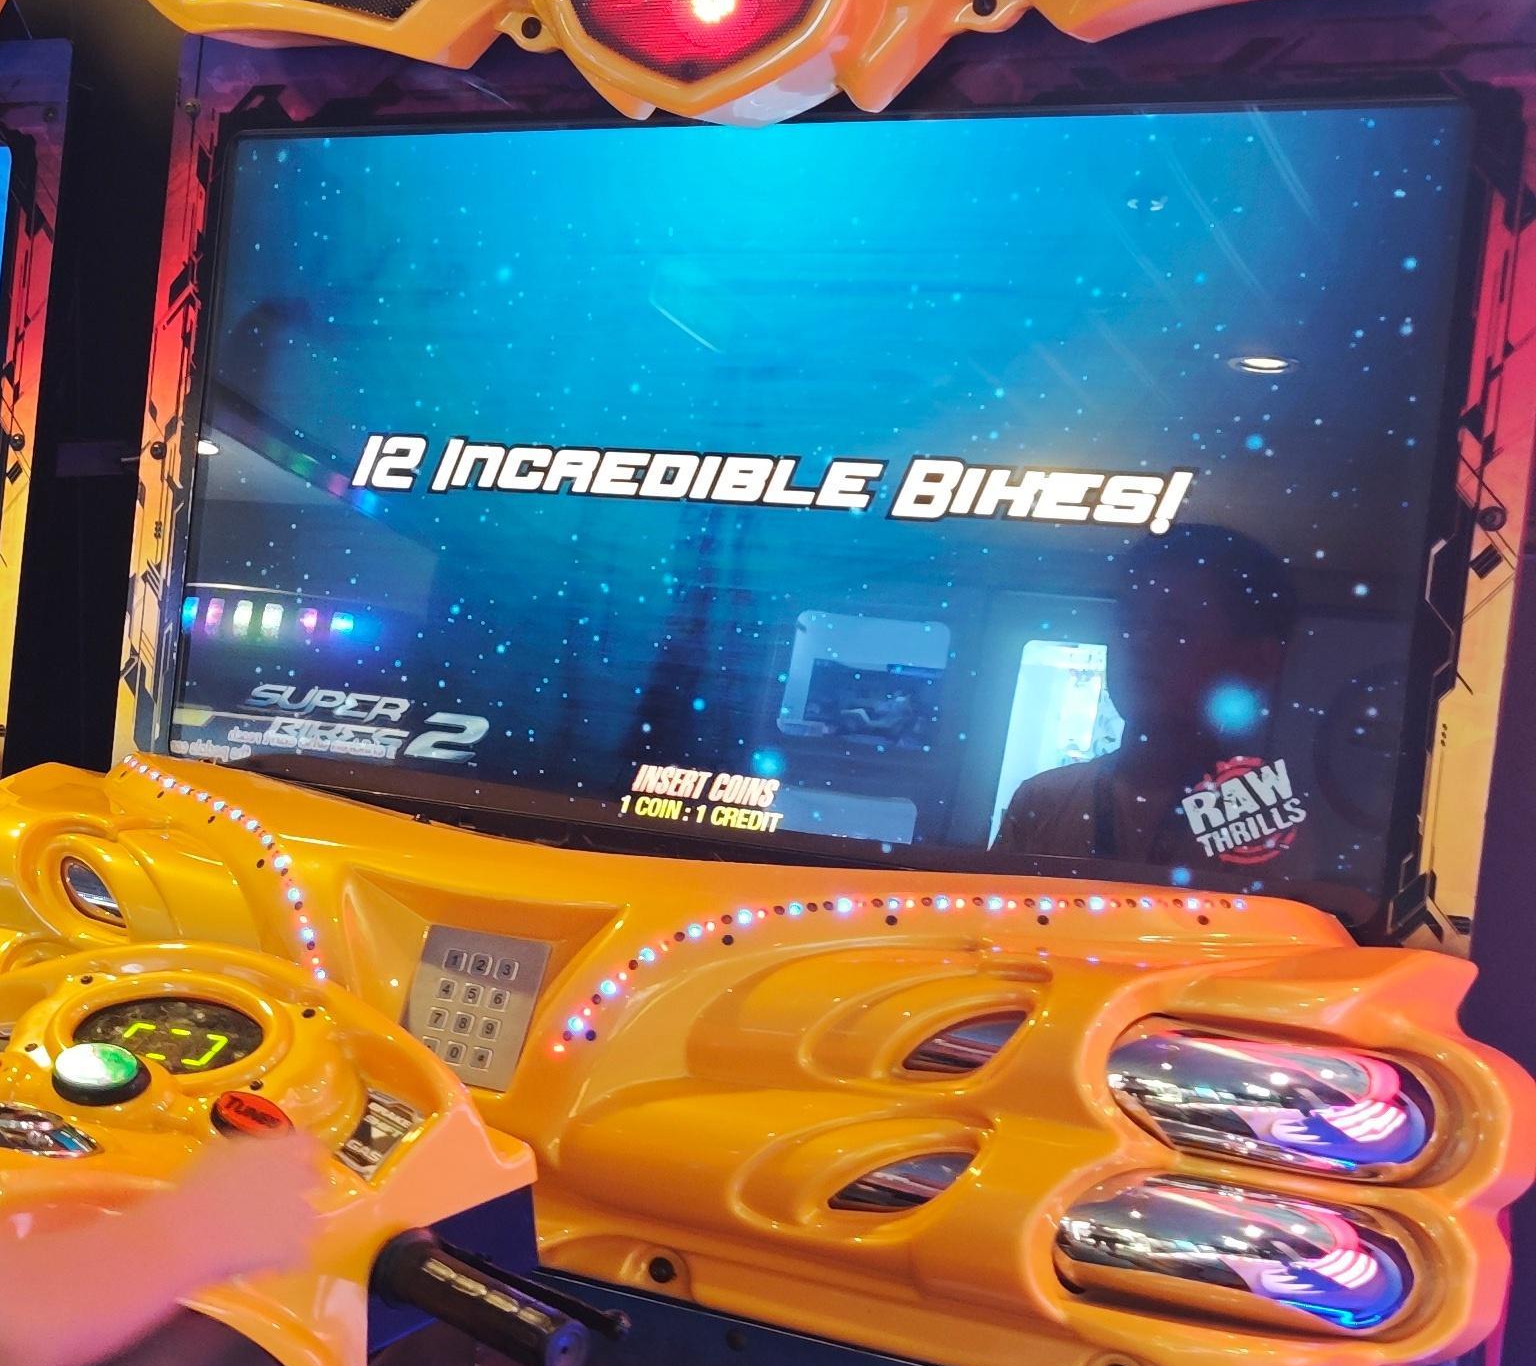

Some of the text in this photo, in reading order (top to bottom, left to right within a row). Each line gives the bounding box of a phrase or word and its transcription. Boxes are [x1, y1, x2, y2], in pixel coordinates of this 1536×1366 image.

[351, 434, 426, 490] 12
[890, 458, 1193, 535] BIKES!
[246, 684, 410, 722] SUPER
[404, 711, 490, 764] 2
[631, 764, 781, 807] INSERT COINS
[1181, 758, 1293, 835] RAW
[620, 795, 632, 814] 1
[635, 796, 684, 820] COIN
[695, 804, 708, 823] 1
[710, 806, 784, 833] CREDIT
[1196, 798, 1307, 858] THRILLS
[345, 1139, 383, 1164] GAS
